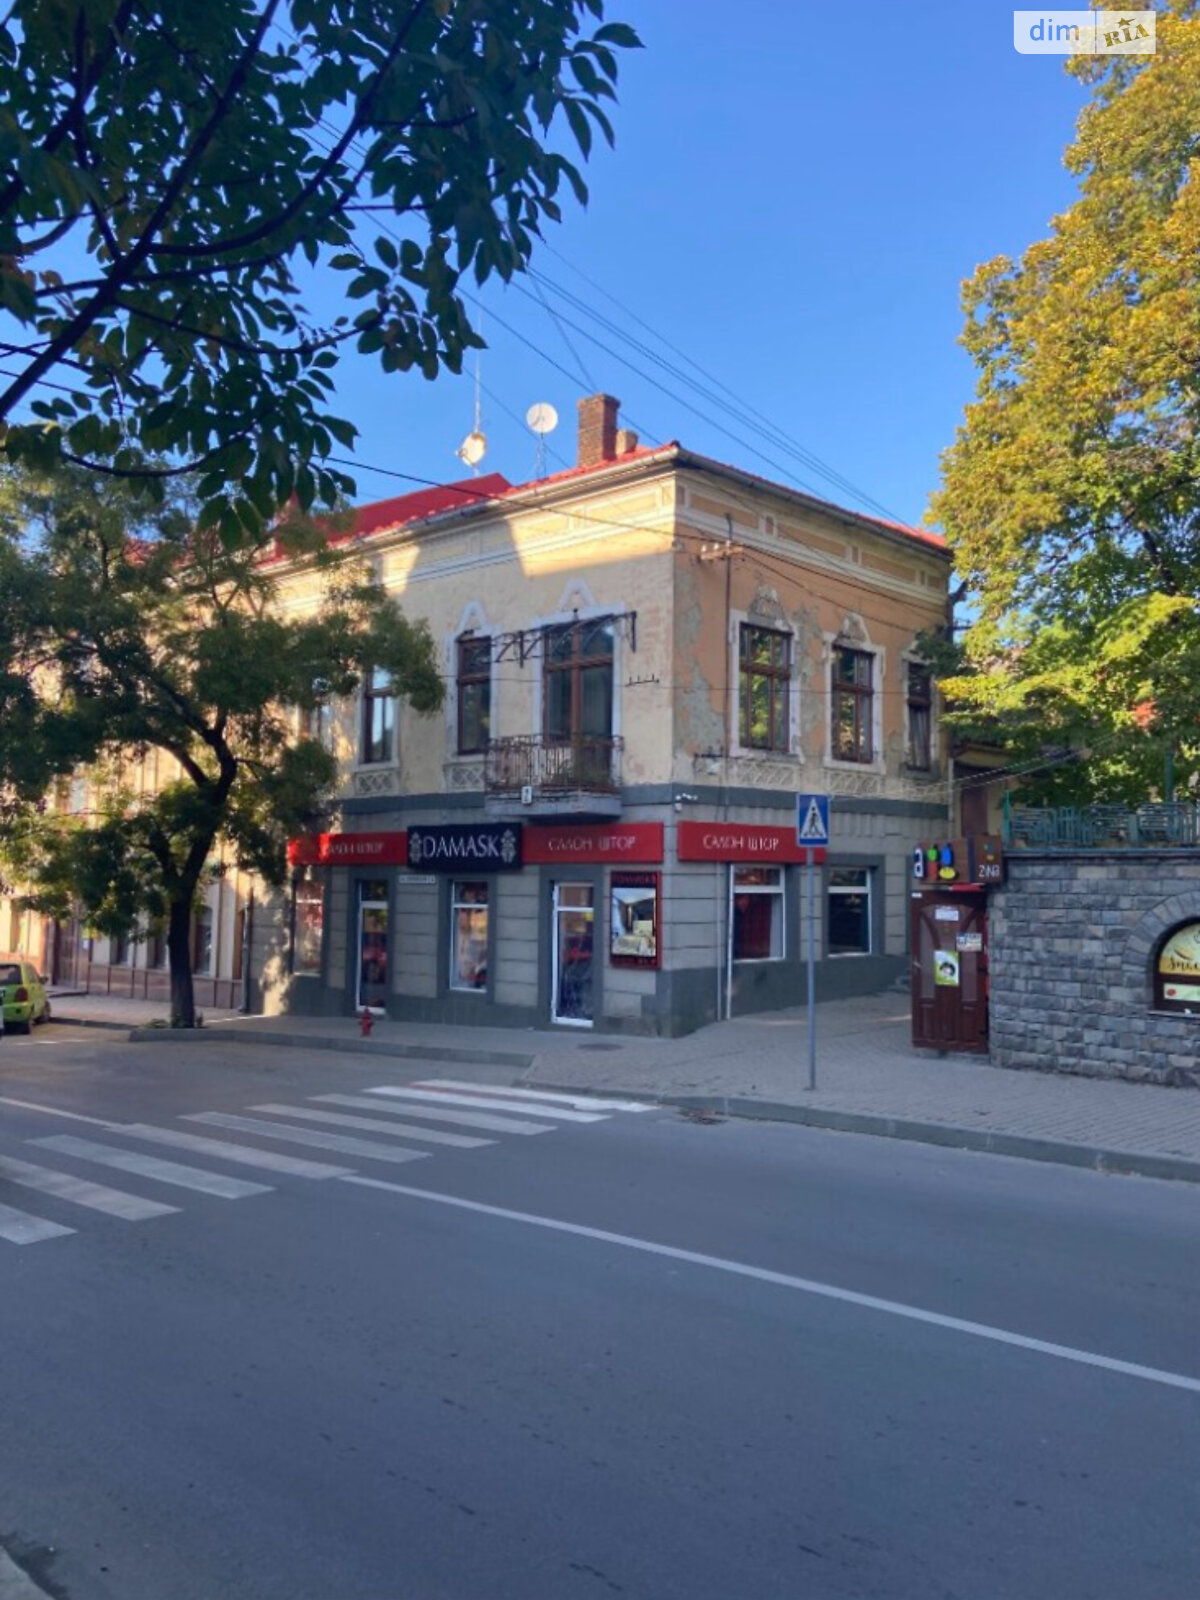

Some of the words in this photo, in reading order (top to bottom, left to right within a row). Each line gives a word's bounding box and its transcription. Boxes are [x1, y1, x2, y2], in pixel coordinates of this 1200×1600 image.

[421, 834, 500, 858] DAMASK
[548, 836, 593, 851] САЛОН
[598, 835, 636, 851] ШТОР
[702, 833, 744, 850] САЛОН
[747, 836, 779, 852] ШТОР
